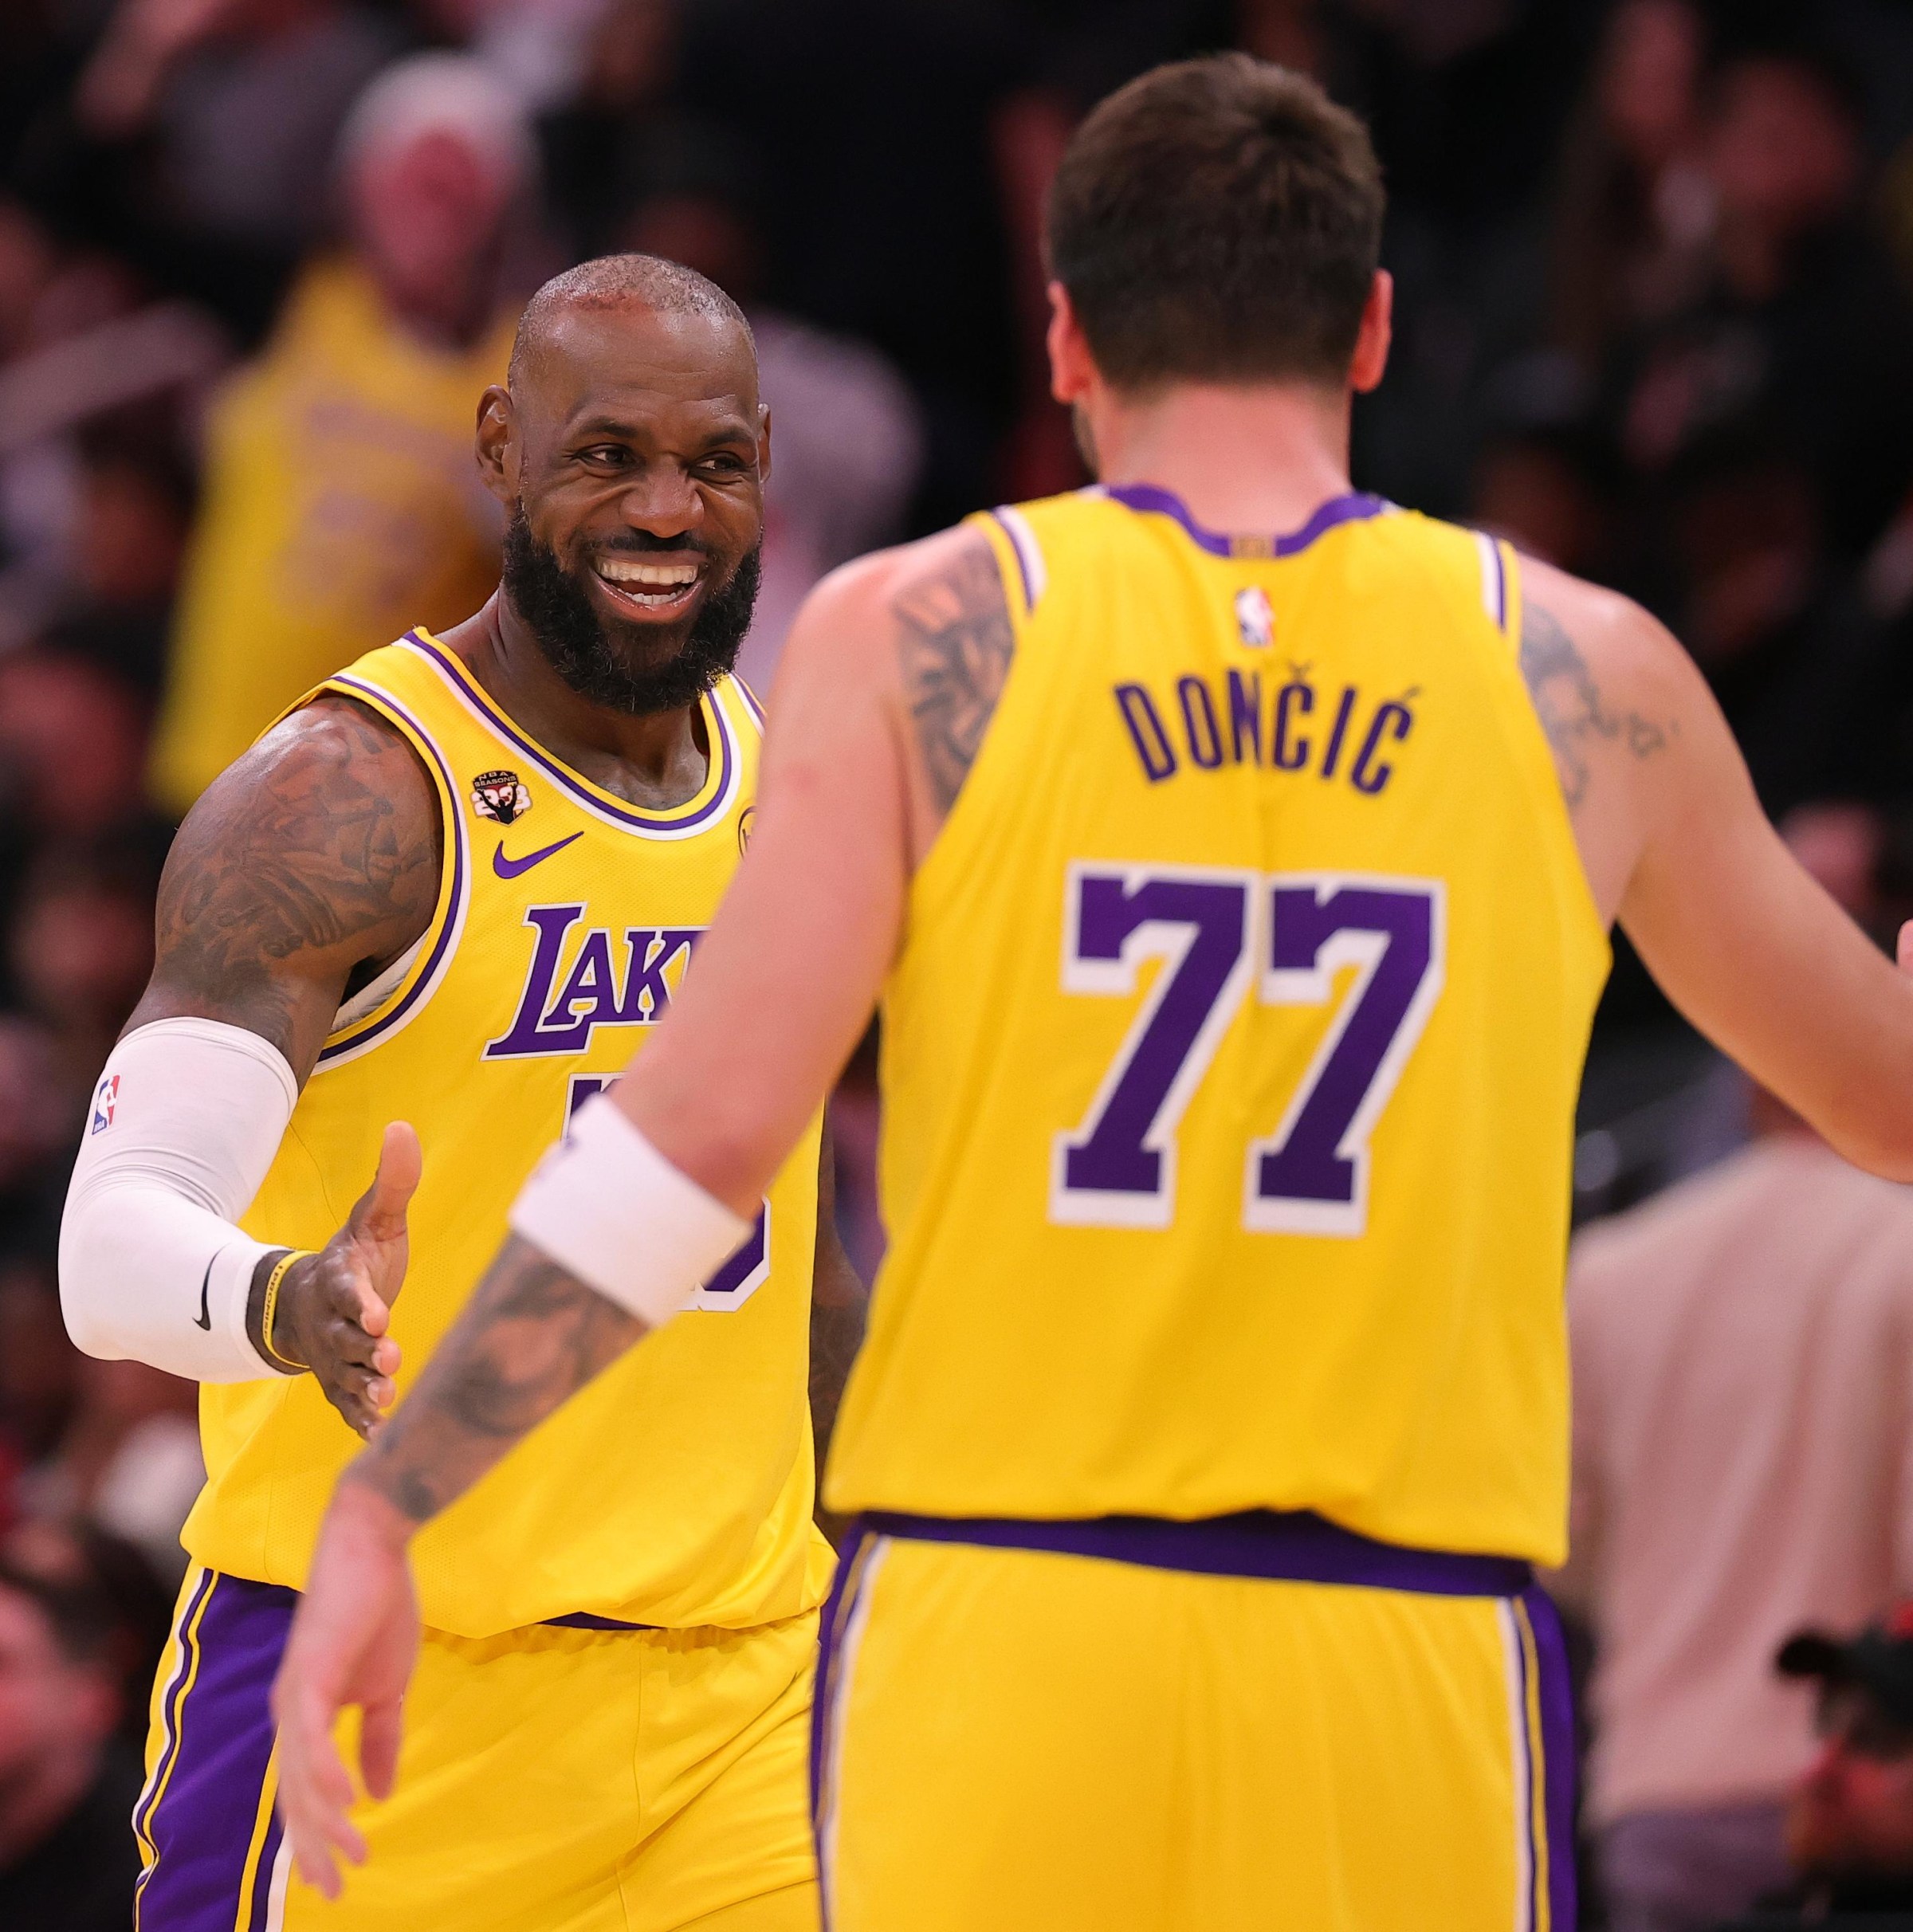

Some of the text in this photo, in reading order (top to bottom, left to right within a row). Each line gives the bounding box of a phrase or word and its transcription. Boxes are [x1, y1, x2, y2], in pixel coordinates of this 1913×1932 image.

[474, 776, 517, 787] SEASONS
[479, 772, 509, 781] NBA
[1116, 660, 1422, 795] DONČIĆ
[480, 901, 712, 1061] LAK
[1049, 859, 1447, 1239] 77
